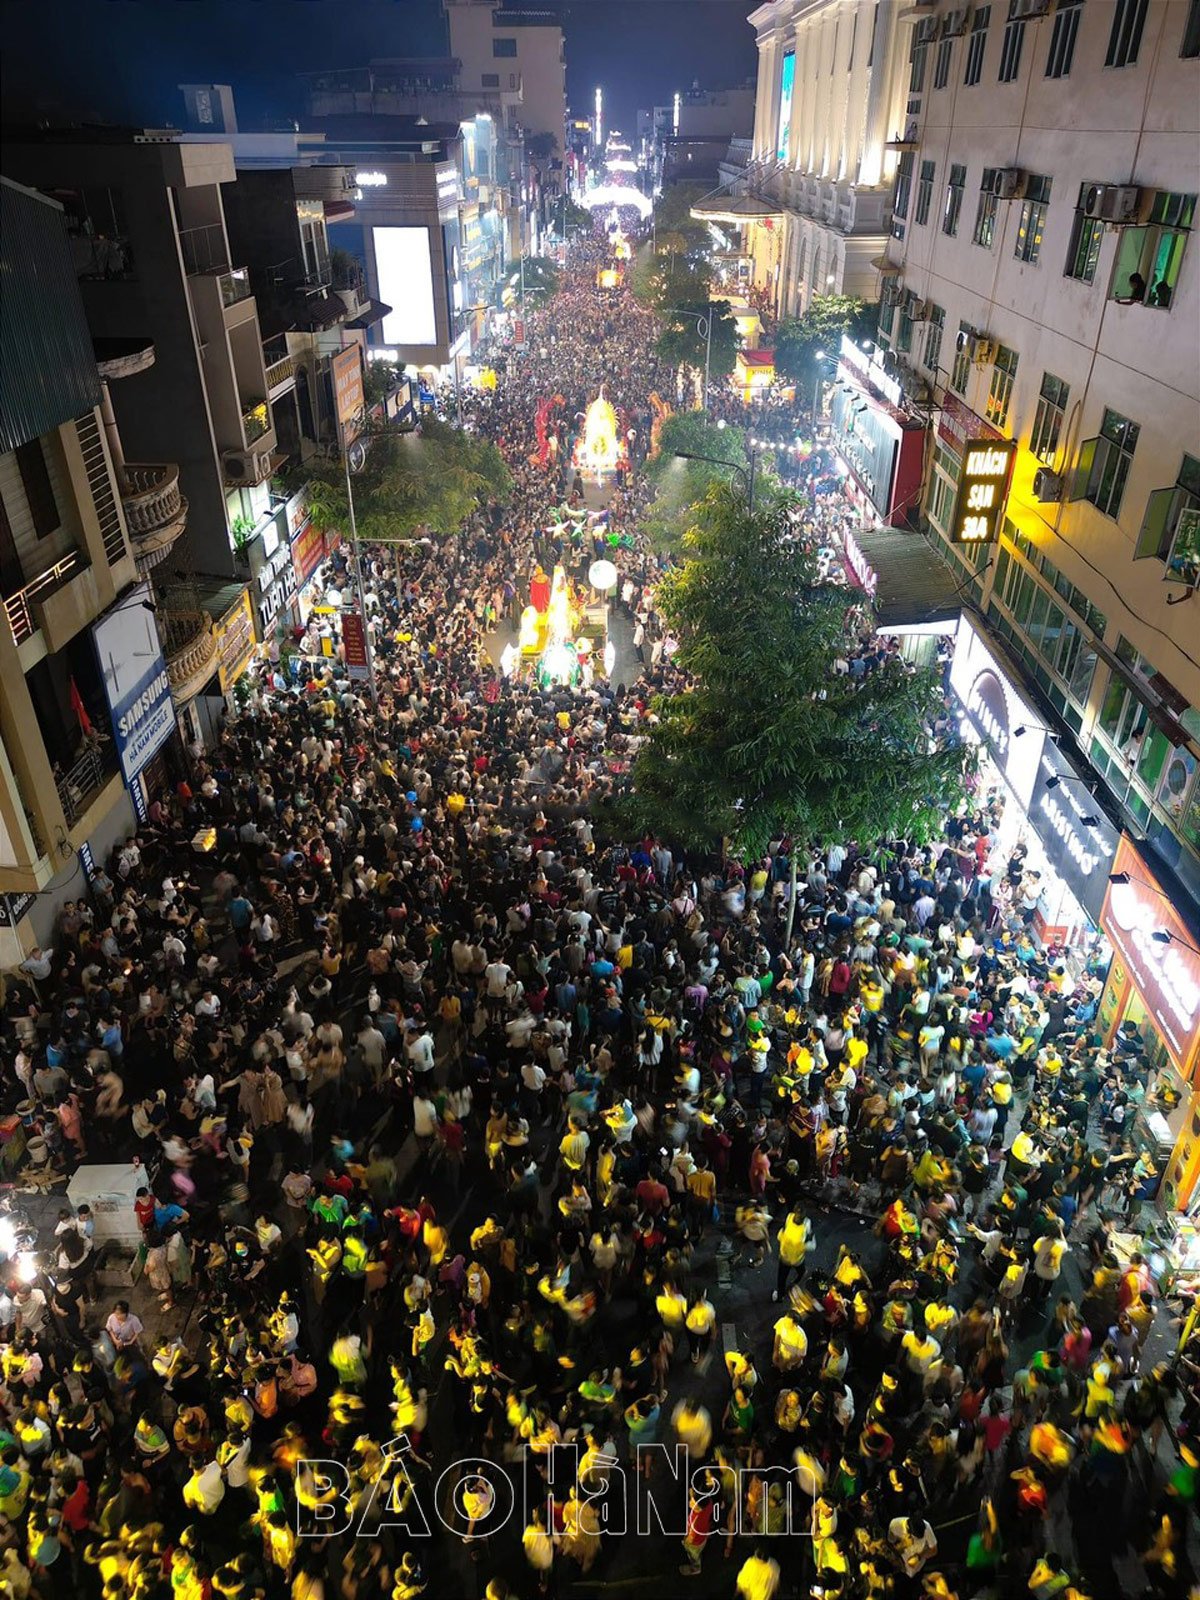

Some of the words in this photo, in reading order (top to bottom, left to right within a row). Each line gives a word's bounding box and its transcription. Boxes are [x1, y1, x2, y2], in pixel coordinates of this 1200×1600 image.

[966, 447, 1008, 475] KHÁCH
[967, 484, 995, 511] SẠN
[119, 670, 168, 738] SAMSUNG
[150, 709, 168, 738] MOBILE
